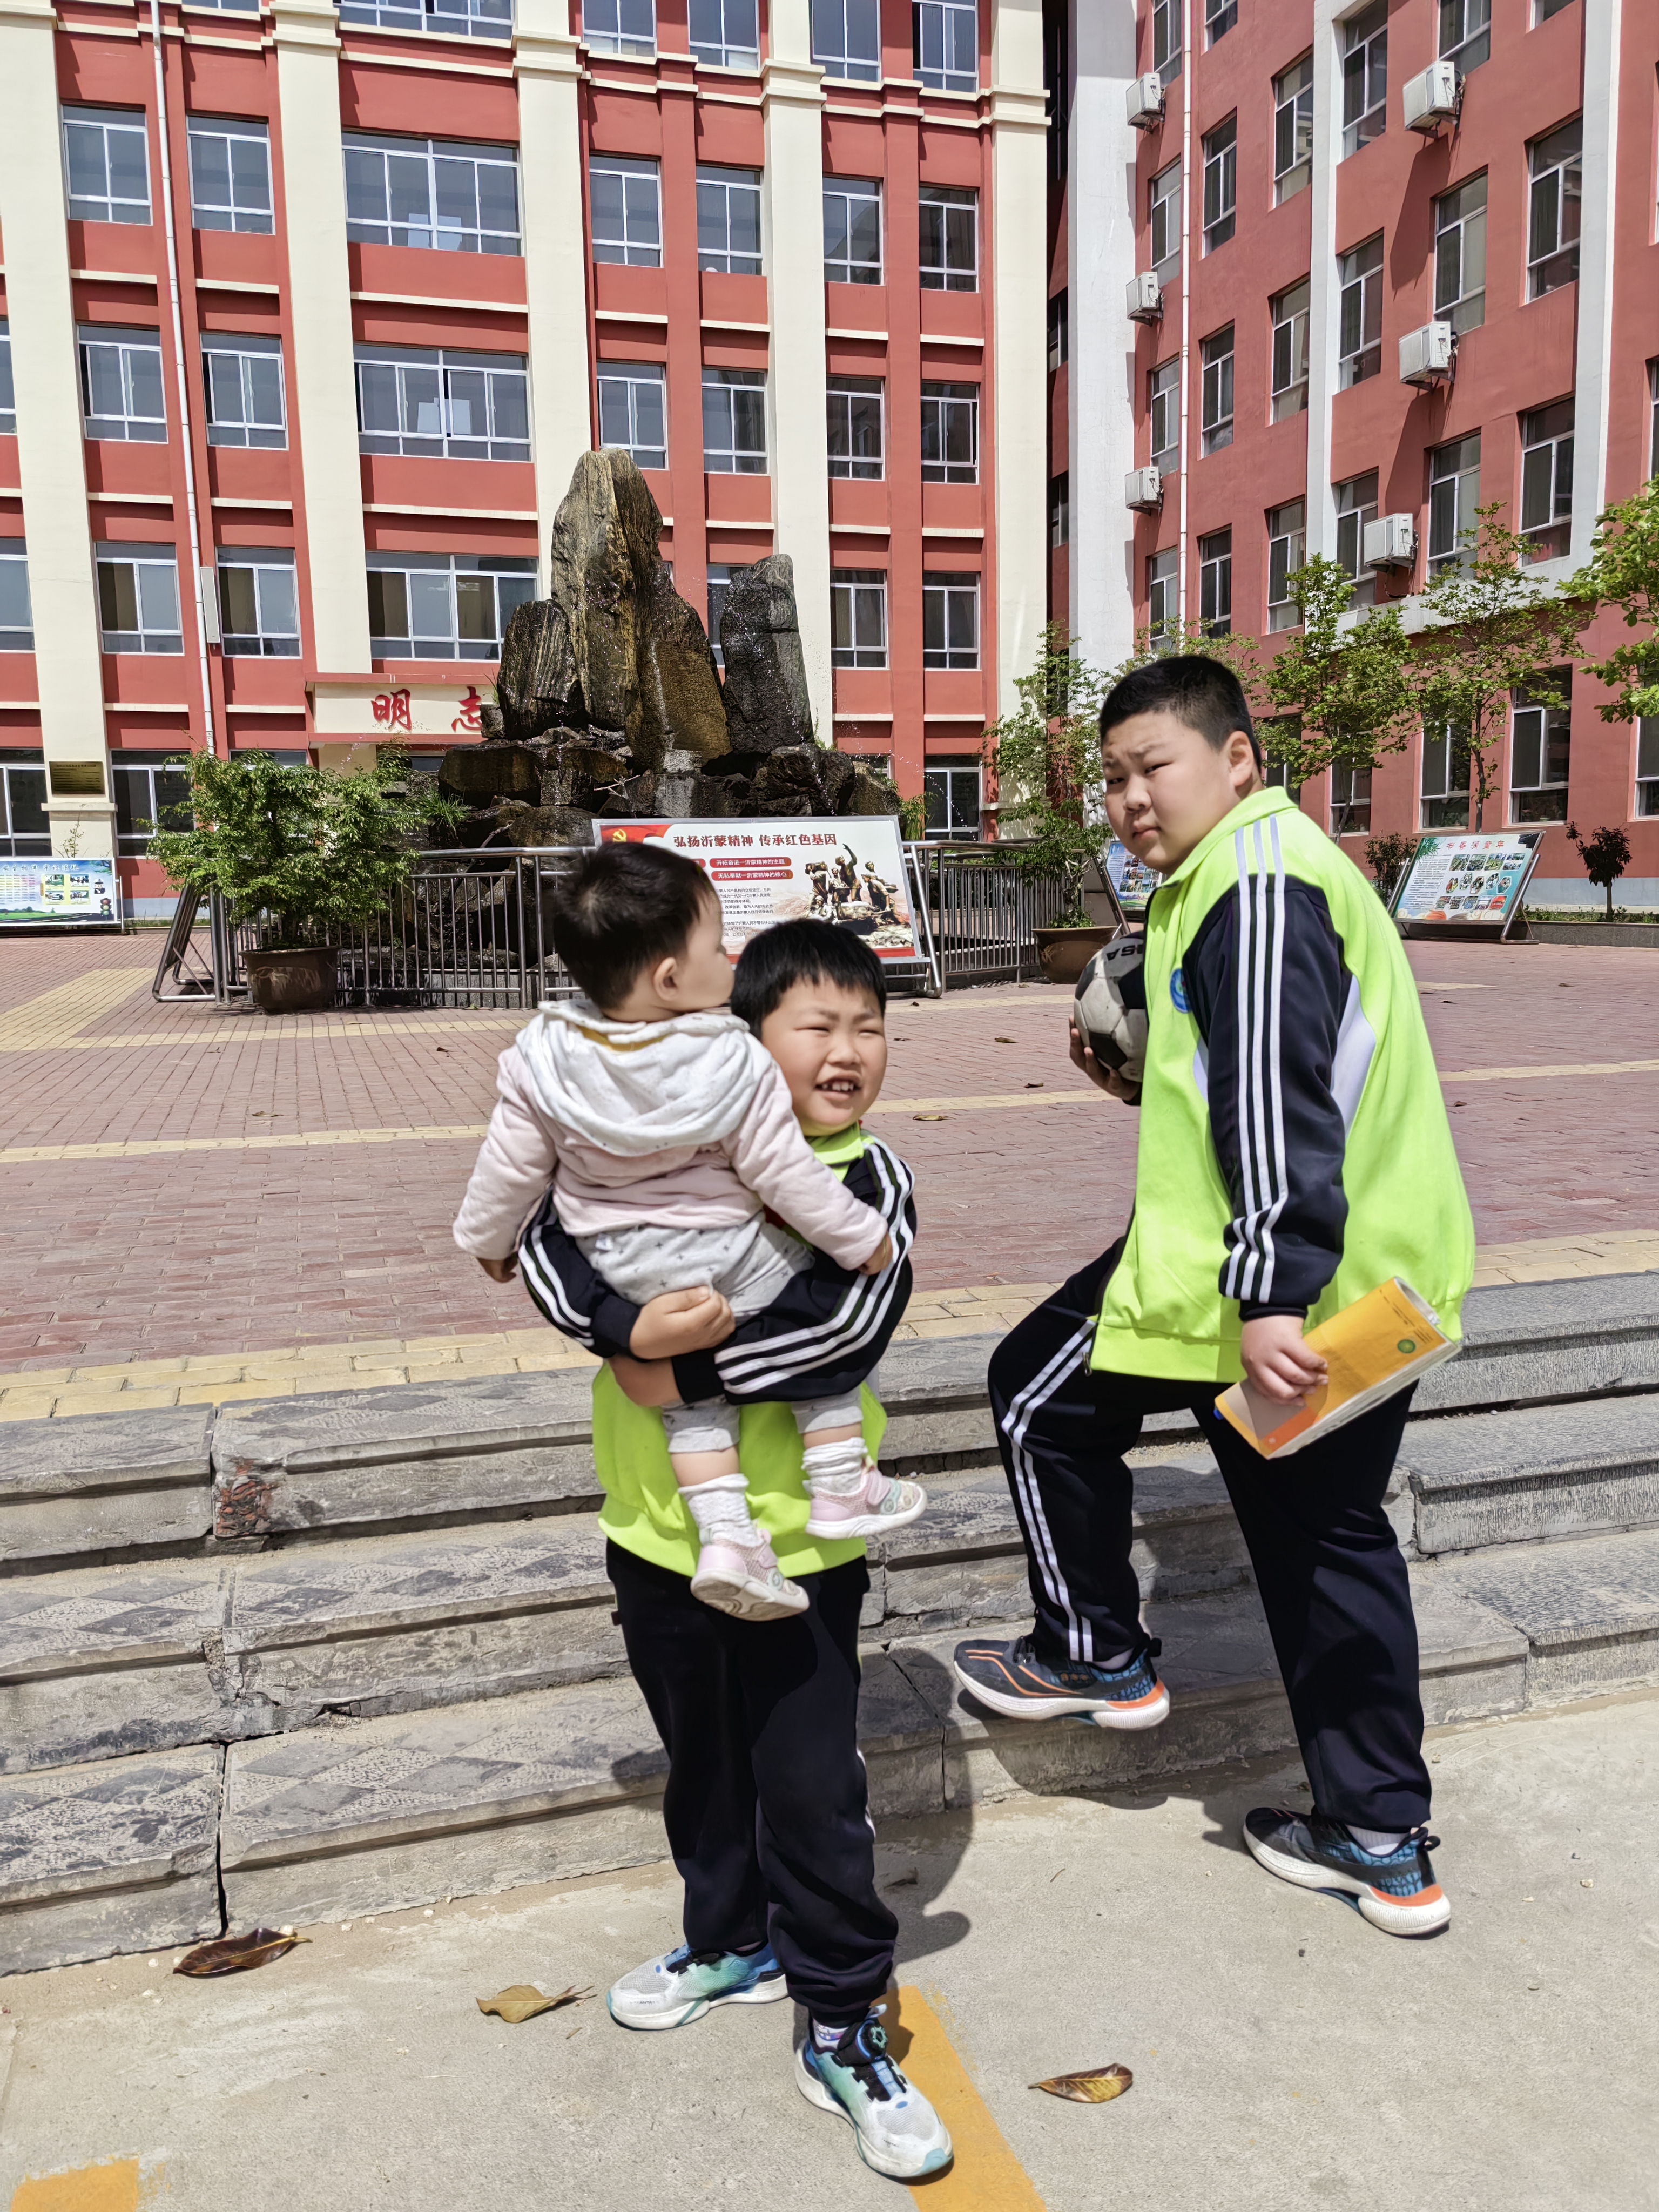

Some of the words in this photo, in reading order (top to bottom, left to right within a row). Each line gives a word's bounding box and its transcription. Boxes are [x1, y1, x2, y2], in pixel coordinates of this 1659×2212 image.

[673, 835, 753, 847] 弘扬沂蒙精神
[759, 833, 837, 846] 传承红色基因
